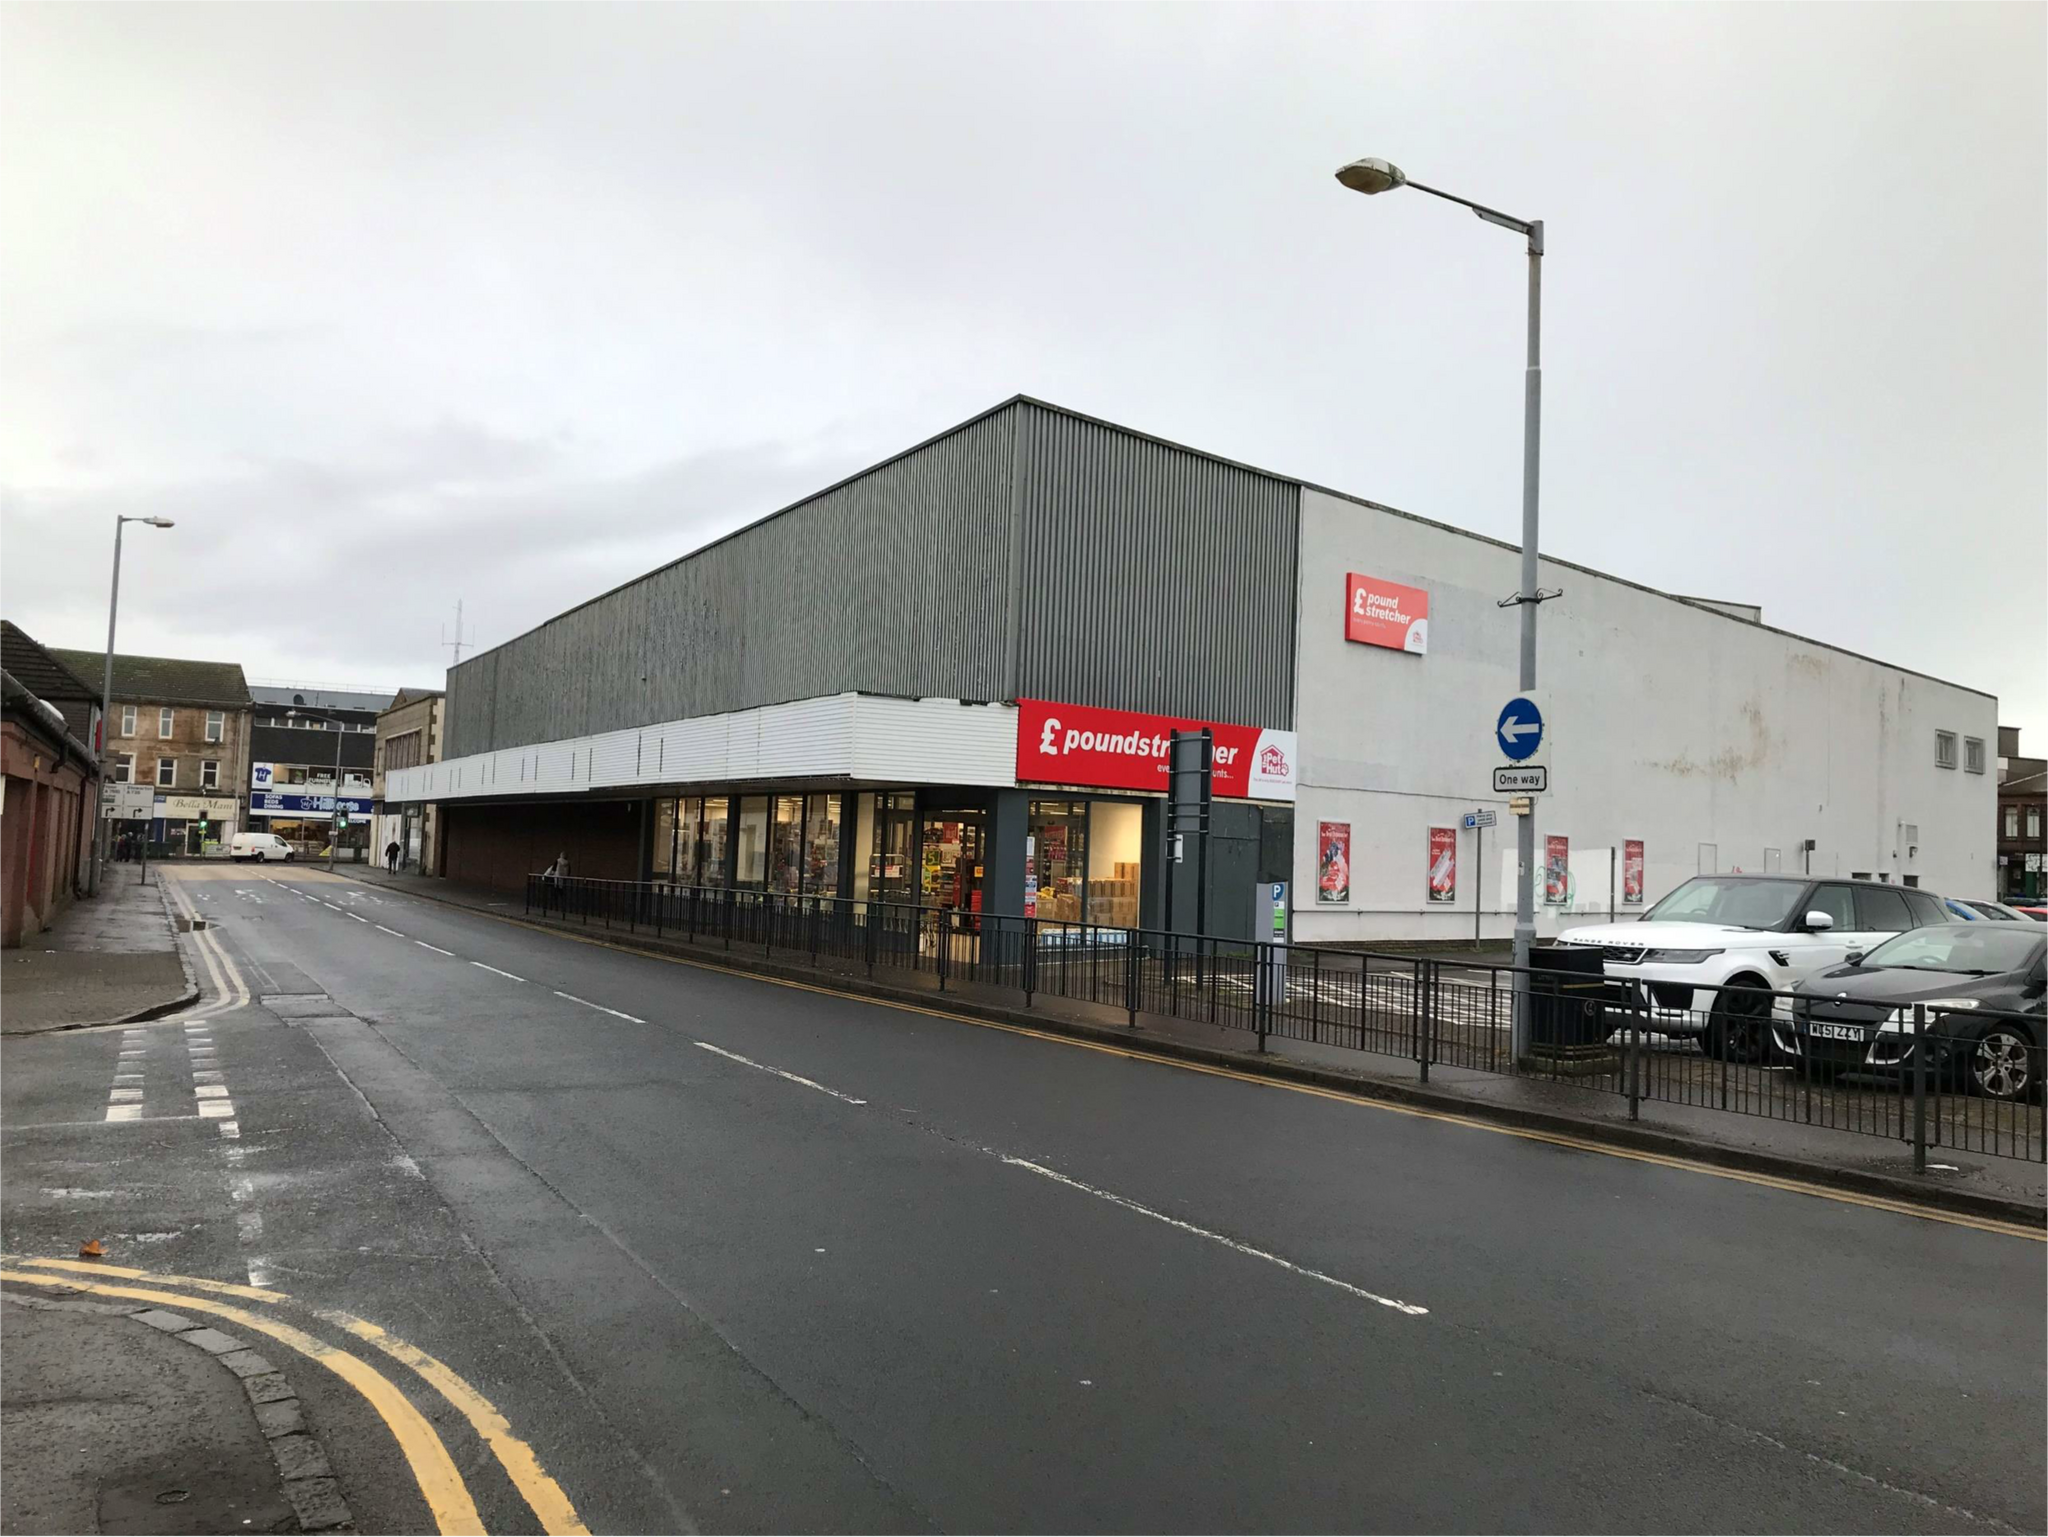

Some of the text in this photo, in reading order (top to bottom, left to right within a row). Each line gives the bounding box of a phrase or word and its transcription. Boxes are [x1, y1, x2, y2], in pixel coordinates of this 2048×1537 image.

[1367, 593, 1399, 609] pound
[1365, 605, 1411, 625] stretcher
[1063, 729, 1239, 765] poundstrer
[1266, 752, 1281, 764] Pet
[1266, 763, 1281, 775] Hut
[1499, 774, 1540, 786] One way
[173, 798, 201, 808] Bella
[1274, 885, 1281, 898] P
[1573, 937, 1603, 945] RANGE
